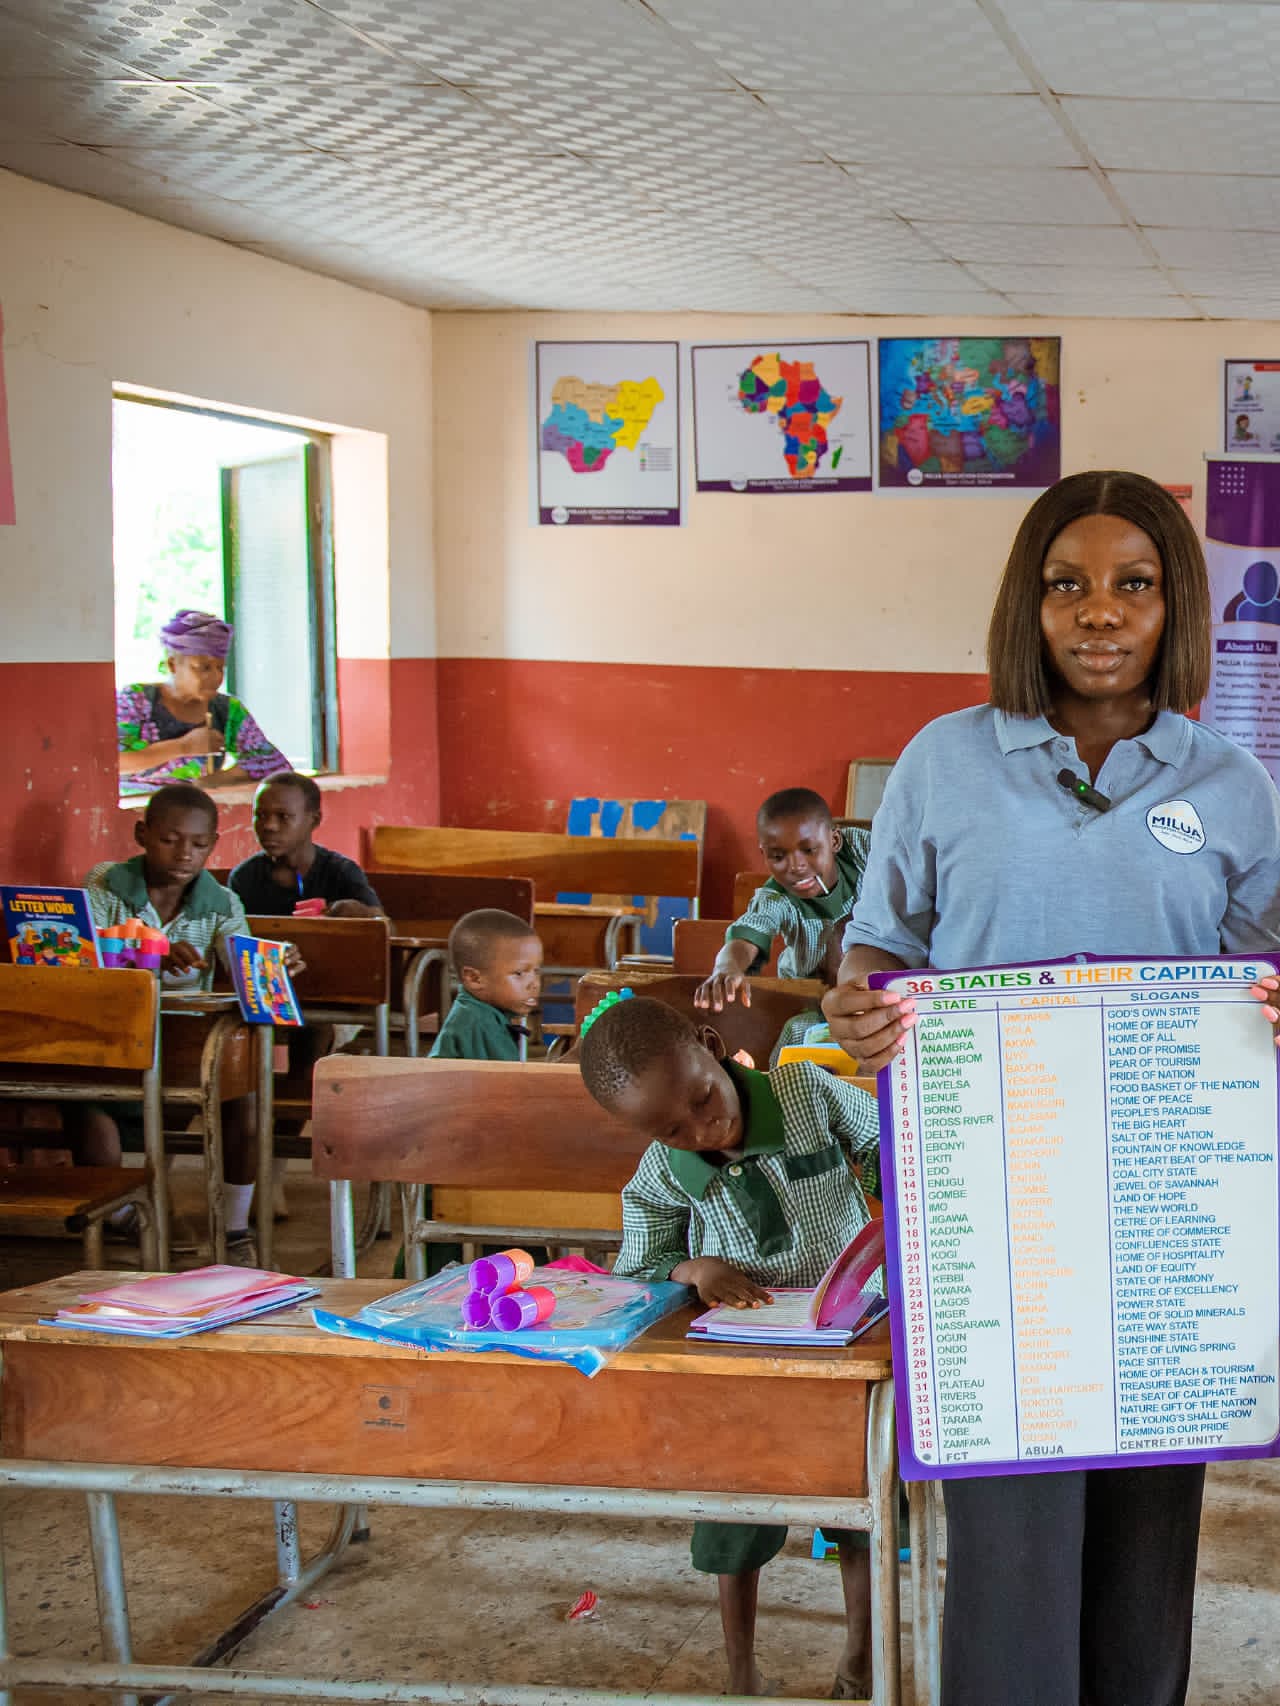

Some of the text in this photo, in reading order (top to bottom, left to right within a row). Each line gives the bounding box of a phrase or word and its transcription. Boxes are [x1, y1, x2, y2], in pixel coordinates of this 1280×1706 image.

[1224, 641, 1253, 651] About
[1152, 815, 1202, 840] MILUA
[9, 900, 76, 915] LETTER WORK
[906, 965, 1258, 994] 36 STATES & THEIR CAPITALS
[1020, 995, 1080, 1007] CAPITAL
[1130, 990, 1200, 1001] SLOGANS
[932, 999, 977, 1010] STATE
[1107, 1006, 1201, 1019] GOD'S OWN STATE
[919, 1017, 945, 1029] ABIA
[920, 1028, 975, 1041] ADAMAWA
[921, 1041, 975, 1054] ANAMBRA
[921, 1053, 983, 1066] AKWA-IBOM
[921, 1067, 962, 1079] BAUCHI
[922, 1080, 971, 1091] BAYELSA
[1110, 1080, 1260, 1094] FOOD BASKET OF THE NATION
[922, 1092, 959, 1104] BENUE
[923, 1104, 962, 1116] BORNO
[1110, 1105, 1213, 1119] PEOPLE'S PARADISE
[924, 1114, 994, 1130] CROSS RIVER
[925, 1129, 958, 1141] DELTA
[925, 1141, 965, 1153] EBONYI
[926, 1154, 952, 1165] EKITI
[926, 1166, 950, 1176] EDO
[927, 1177, 964, 1188] ENUGU
[928, 1189, 967, 1200] GOMBE
[1113, 1191, 1187, 1203] LAND OF HOPE
[928, 1202, 948, 1213] IMO
[930, 1225, 974, 1236] KADUNA
[930, 1238, 961, 1248] KANO
[931, 1249, 957, 1260] KOGI
[931, 1261, 976, 1272] KATSINA
[932, 1273, 964, 1285] KEBBI
[933, 1285, 972, 1296] KWARA
[1116, 1284, 1239, 1298] CENTRE OF EXCELLENCY
[934, 1297, 970, 1308] LAGOS
[935, 1309, 966, 1320] NIGER
[936, 1319, 1000, 1331] NASSARAWA
[936, 1333, 967, 1343] OGUN
[1118, 1332, 1199, 1345] SUNSHINE STATE
[937, 1344, 967, 1355] ONDO
[937, 1356, 967, 1367] OSUN
[1118, 1356, 1181, 1369] PACE SITTER
[938, 1368, 961, 1378] OYO
[939, 1379, 985, 1390] PLATEAU
[940, 1391, 977, 1402] RIVERS
[940, 1402, 983, 1413] SOKOTO
[941, 1414, 982, 1425] TARABA
[942, 1427, 970, 1437] YOBE
[943, 1437, 991, 1449] ZAMFARA
[1119, 1434, 1223, 1450] CENTRE OF UNITY
[1025, 1445, 1064, 1456] ABUJA
[946, 1451, 969, 1462] FCT
